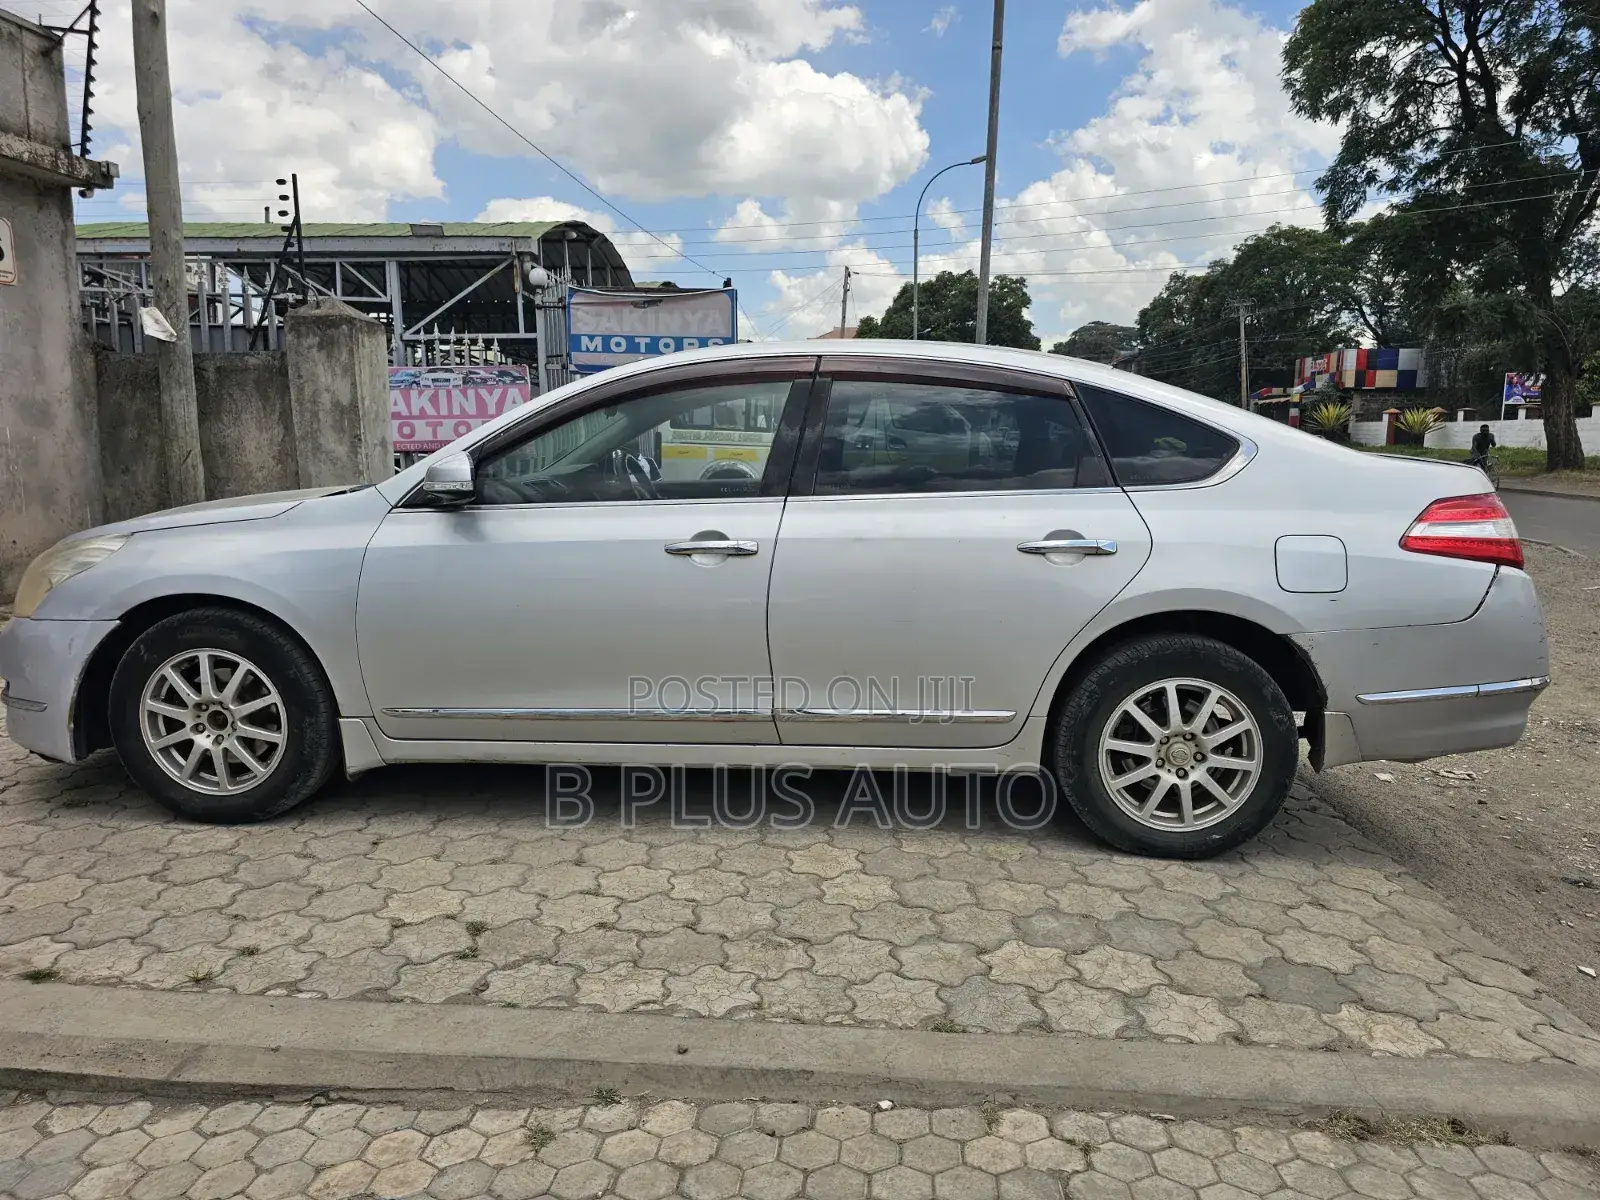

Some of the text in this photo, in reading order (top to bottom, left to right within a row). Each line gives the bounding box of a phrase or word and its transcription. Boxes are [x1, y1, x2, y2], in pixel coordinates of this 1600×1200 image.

[575, 306, 727, 334] SAKINYA
[389, 388, 525, 416] AKINYA
[397, 420, 490, 440] OTO
